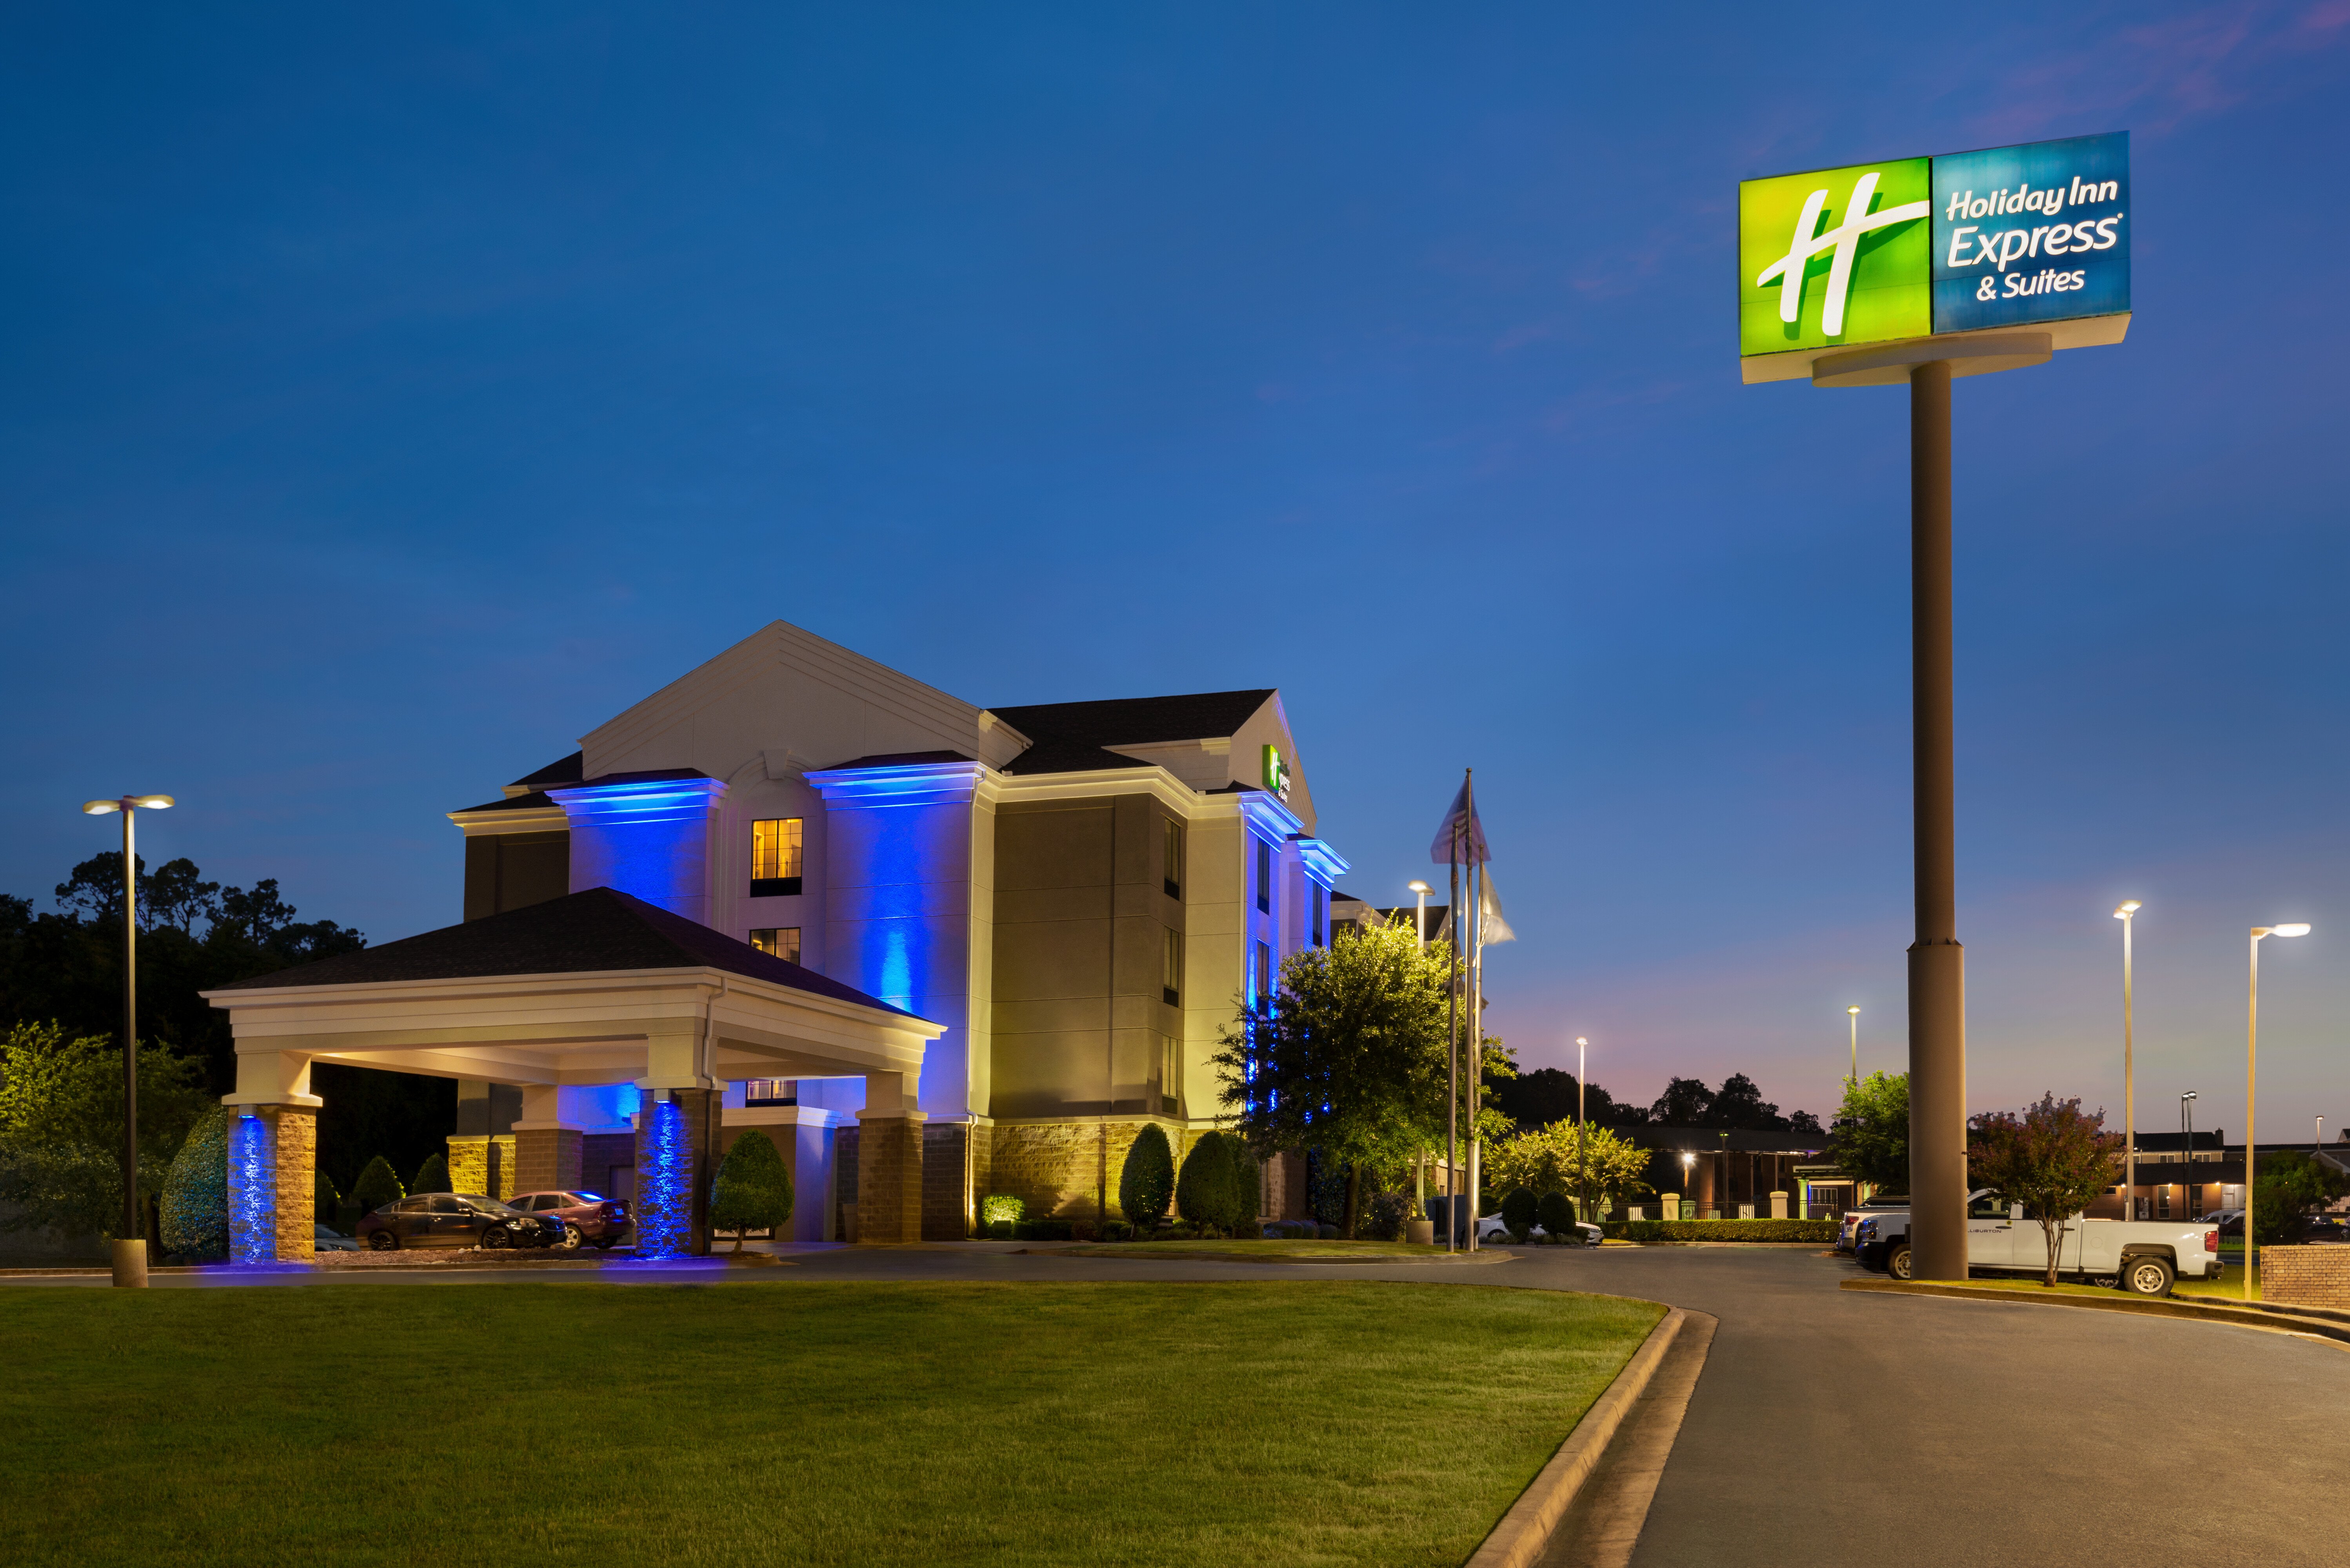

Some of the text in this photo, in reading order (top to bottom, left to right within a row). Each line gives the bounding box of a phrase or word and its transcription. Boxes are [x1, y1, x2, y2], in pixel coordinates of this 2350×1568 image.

[1946, 176, 2117, 221] Holiday Inn
[1757, 172, 1930, 336] H
[1976, 269, 2085, 301] & Suites
